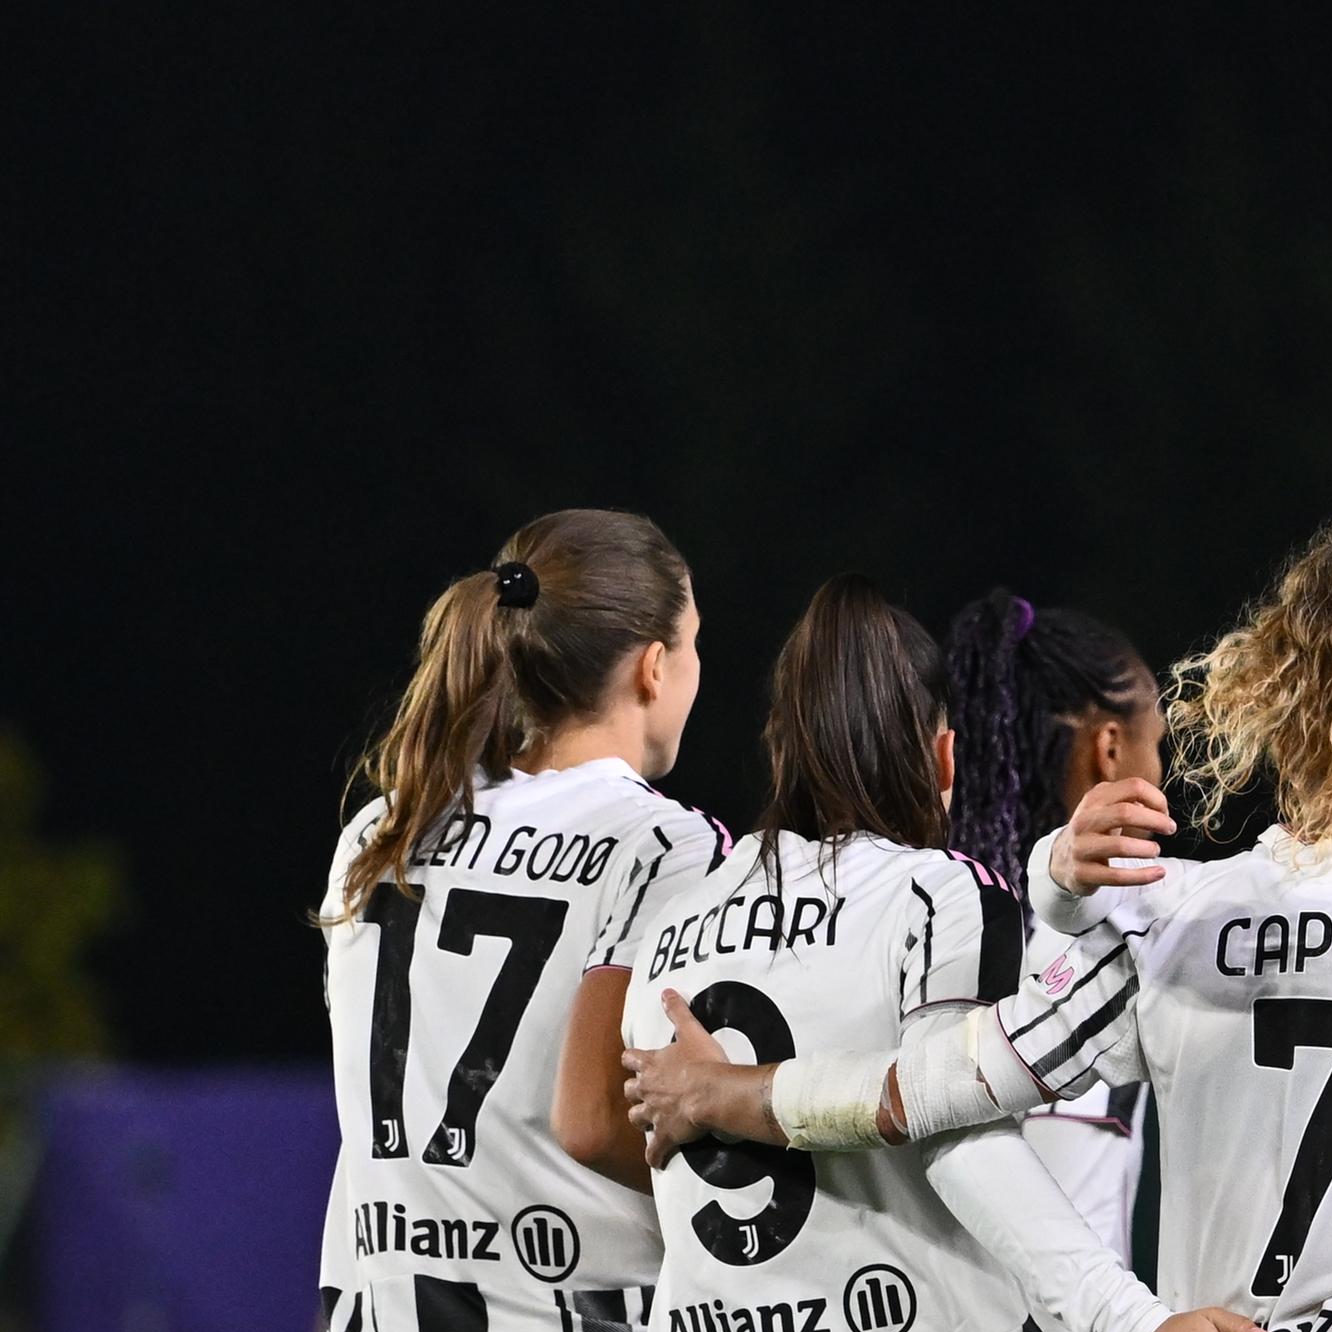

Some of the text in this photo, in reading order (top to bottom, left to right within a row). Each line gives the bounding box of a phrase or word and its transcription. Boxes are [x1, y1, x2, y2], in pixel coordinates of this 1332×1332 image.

[648, 894, 845, 983] BECCARI
[358, 883, 570, 1168] 17
[354, 1201, 501, 1262] Allianz
